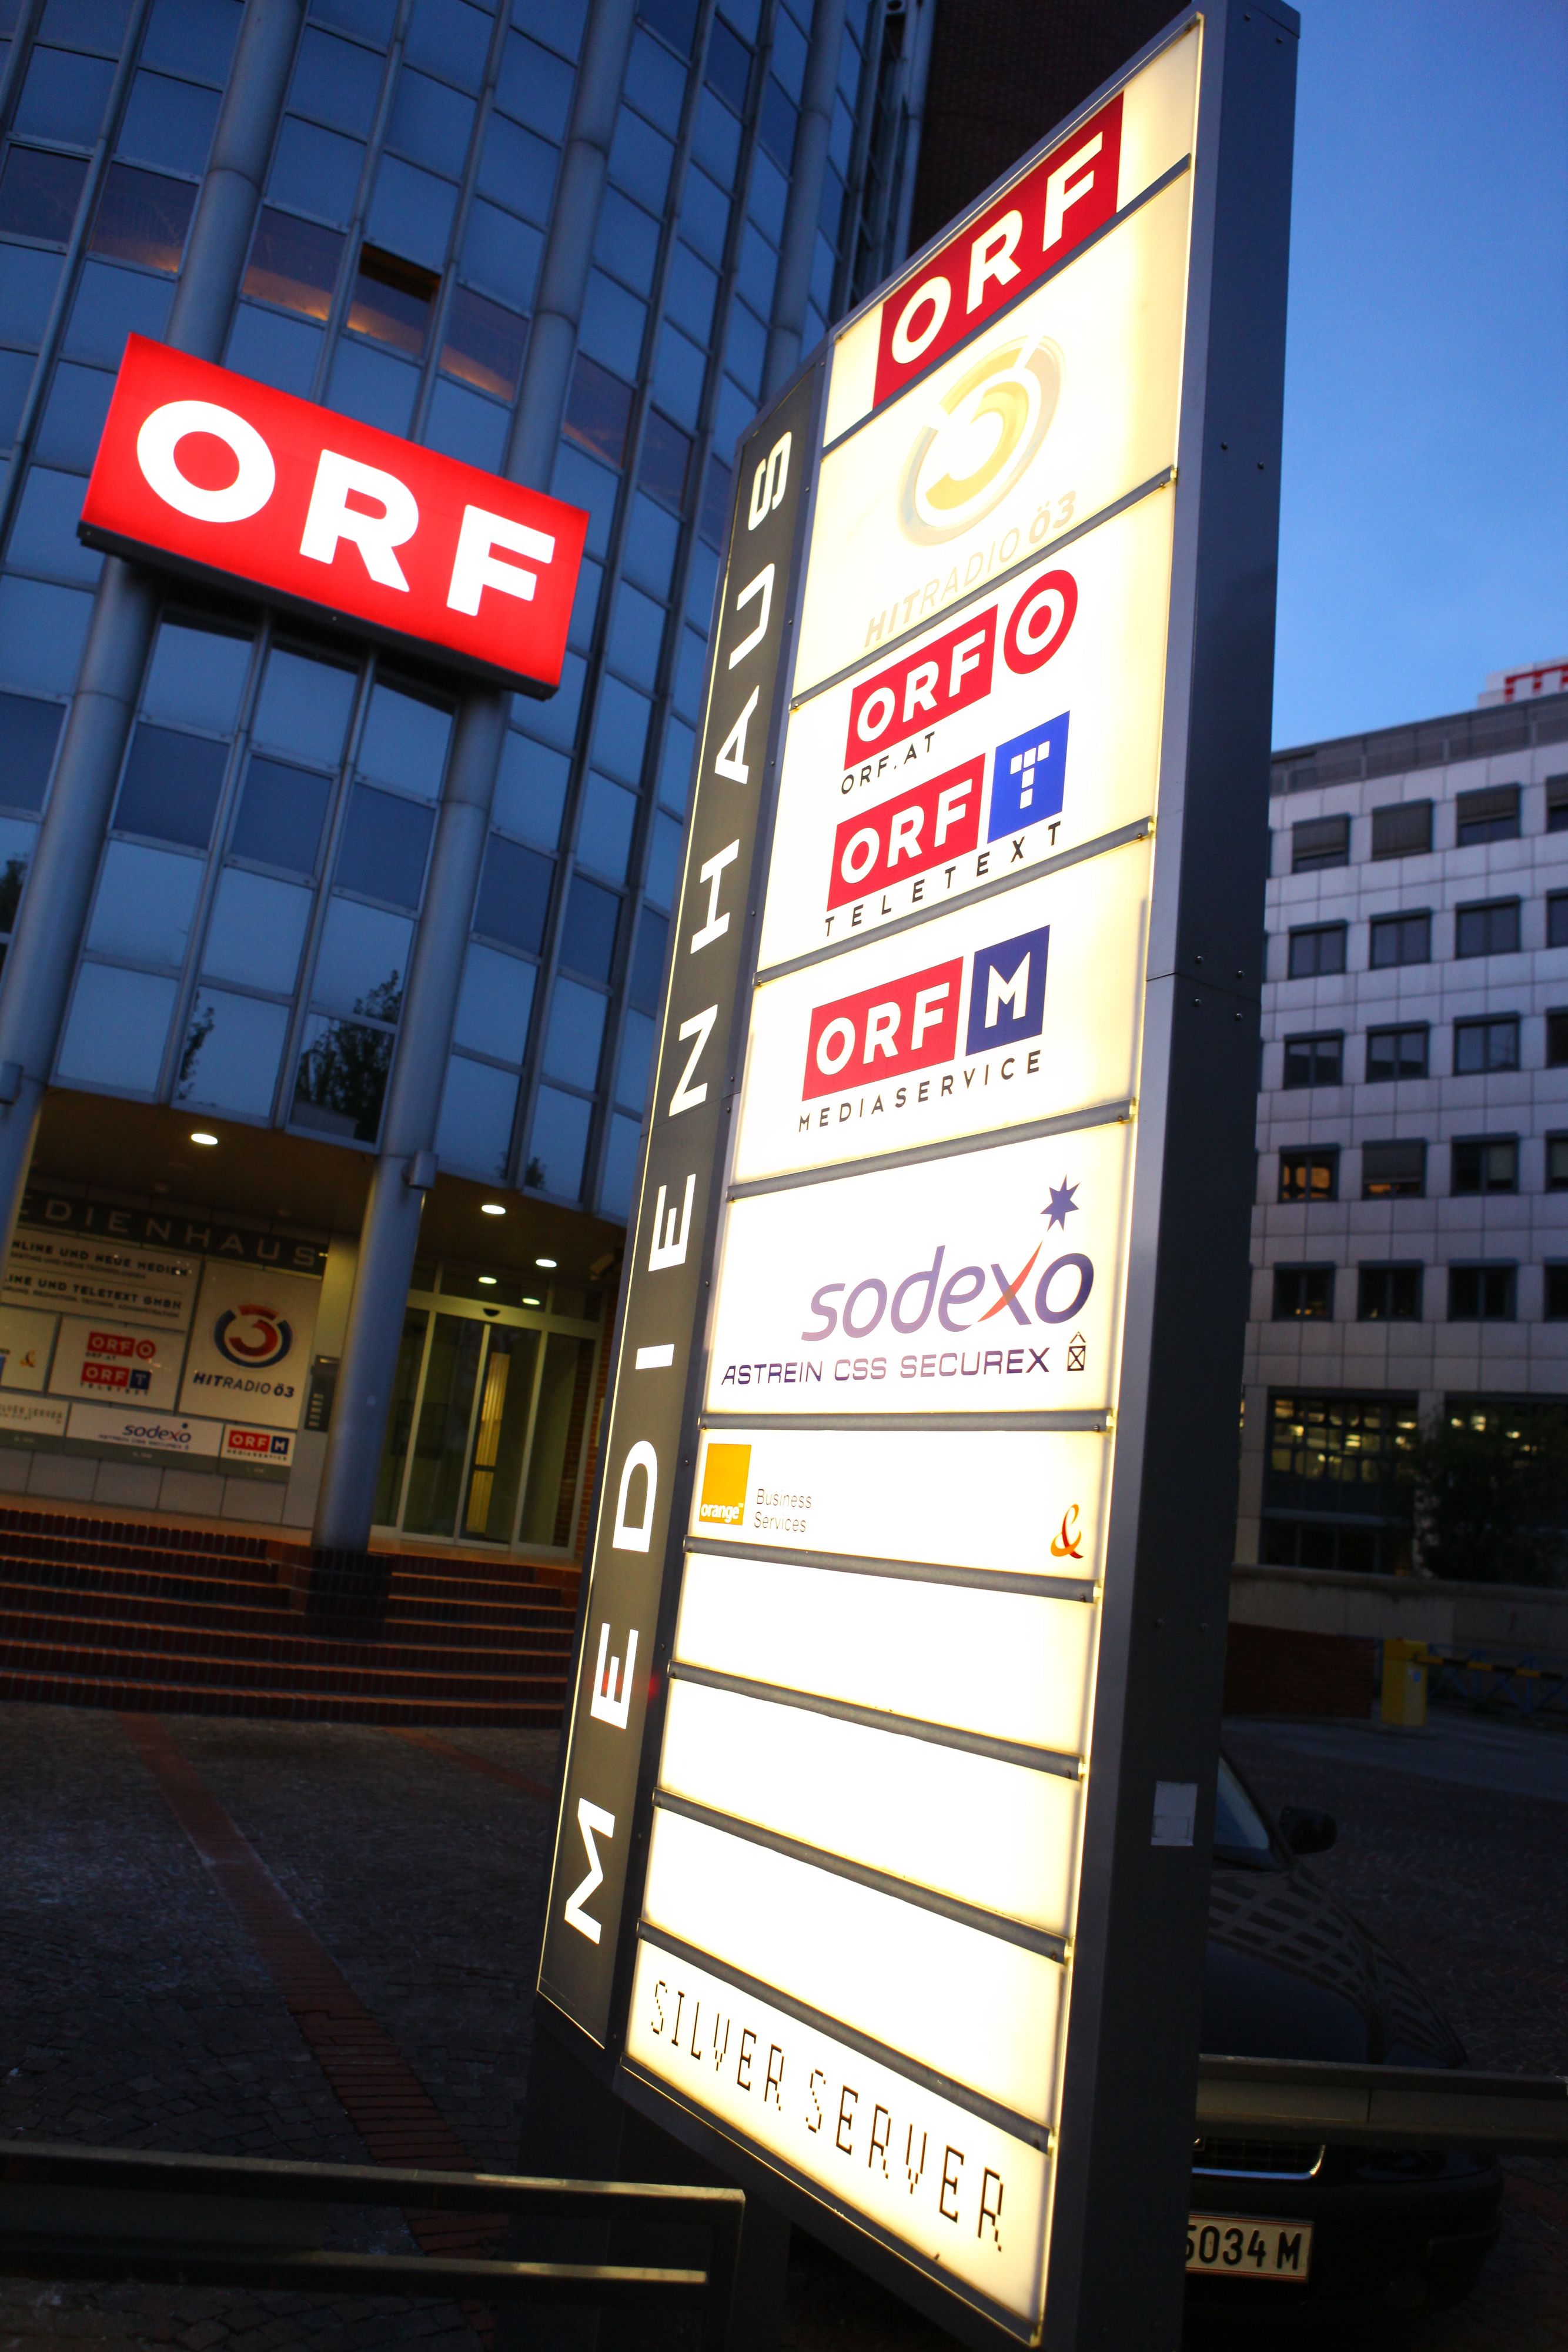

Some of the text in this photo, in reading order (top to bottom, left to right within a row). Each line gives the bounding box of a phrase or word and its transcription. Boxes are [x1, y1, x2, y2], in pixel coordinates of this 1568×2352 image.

[892, 131, 1103, 364] ORF
[136, 400, 556, 616] ORF
[864, 491, 1076, 648] HITRADIO Ö3
[857, 629, 986, 742] ORF
[841, 731, 935, 794] ORF.AT
[841, 779, 972, 884] ORF
[825, 821, 1061, 937] TELETEXT
[816, 982, 950, 1075] ORF
[798, 1050, 1041, 1132] MEDIASERVICE
[563, 431, 792, 1945] MEDIENHAUS
[60, 1247, 89, 1261] UND
[38, 1278, 67, 1291] UND
[73, 1284, 139, 1303] TELETEXT
[801, 1240, 1094, 1342] sodexo
[85, 1366, 126, 1383] ORF
[91, 1335, 132, 1353] ORF
[721, 1347, 1051, 1385] ASTREIN CSS SECUREX
[193, 1372, 271, 1395] HITRADIO
[122, 1424, 192, 1444] sodexo
[232, 1434, 268, 1448] ORF
[700, 1503, 740, 1524] orange
[754, 1511, 807, 1532] Services
[756, 1489, 812, 1509] Business
[651, 1980, 1004, 2253] SILVER SERVER
